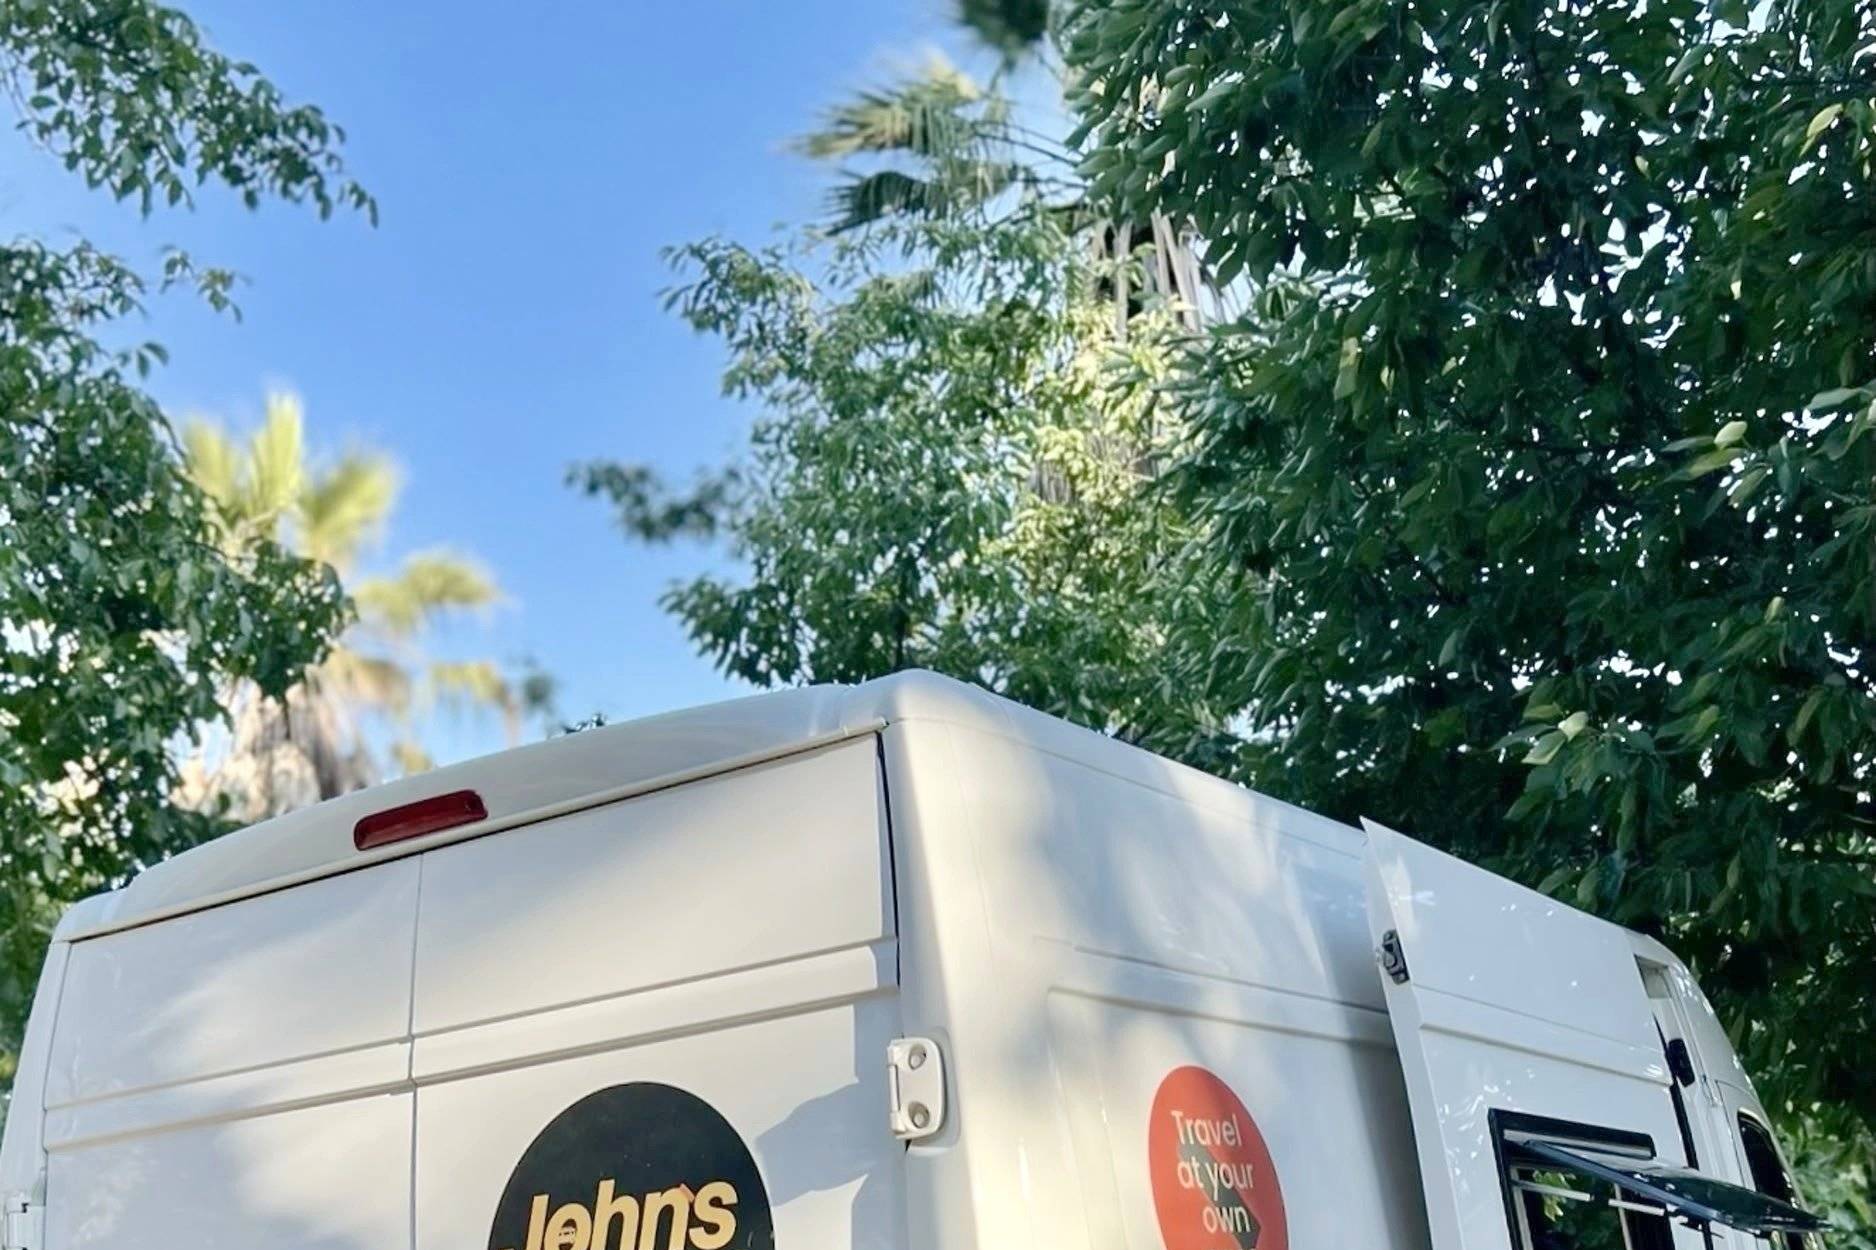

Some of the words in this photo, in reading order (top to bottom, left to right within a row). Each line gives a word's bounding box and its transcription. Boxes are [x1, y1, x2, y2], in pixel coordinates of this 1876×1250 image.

[1171, 1110, 1242, 1147] Travel
[1177, 1155, 1203, 1189] at
[1207, 1161, 1254, 1201] your
[1203, 1205, 1251, 1234] own
